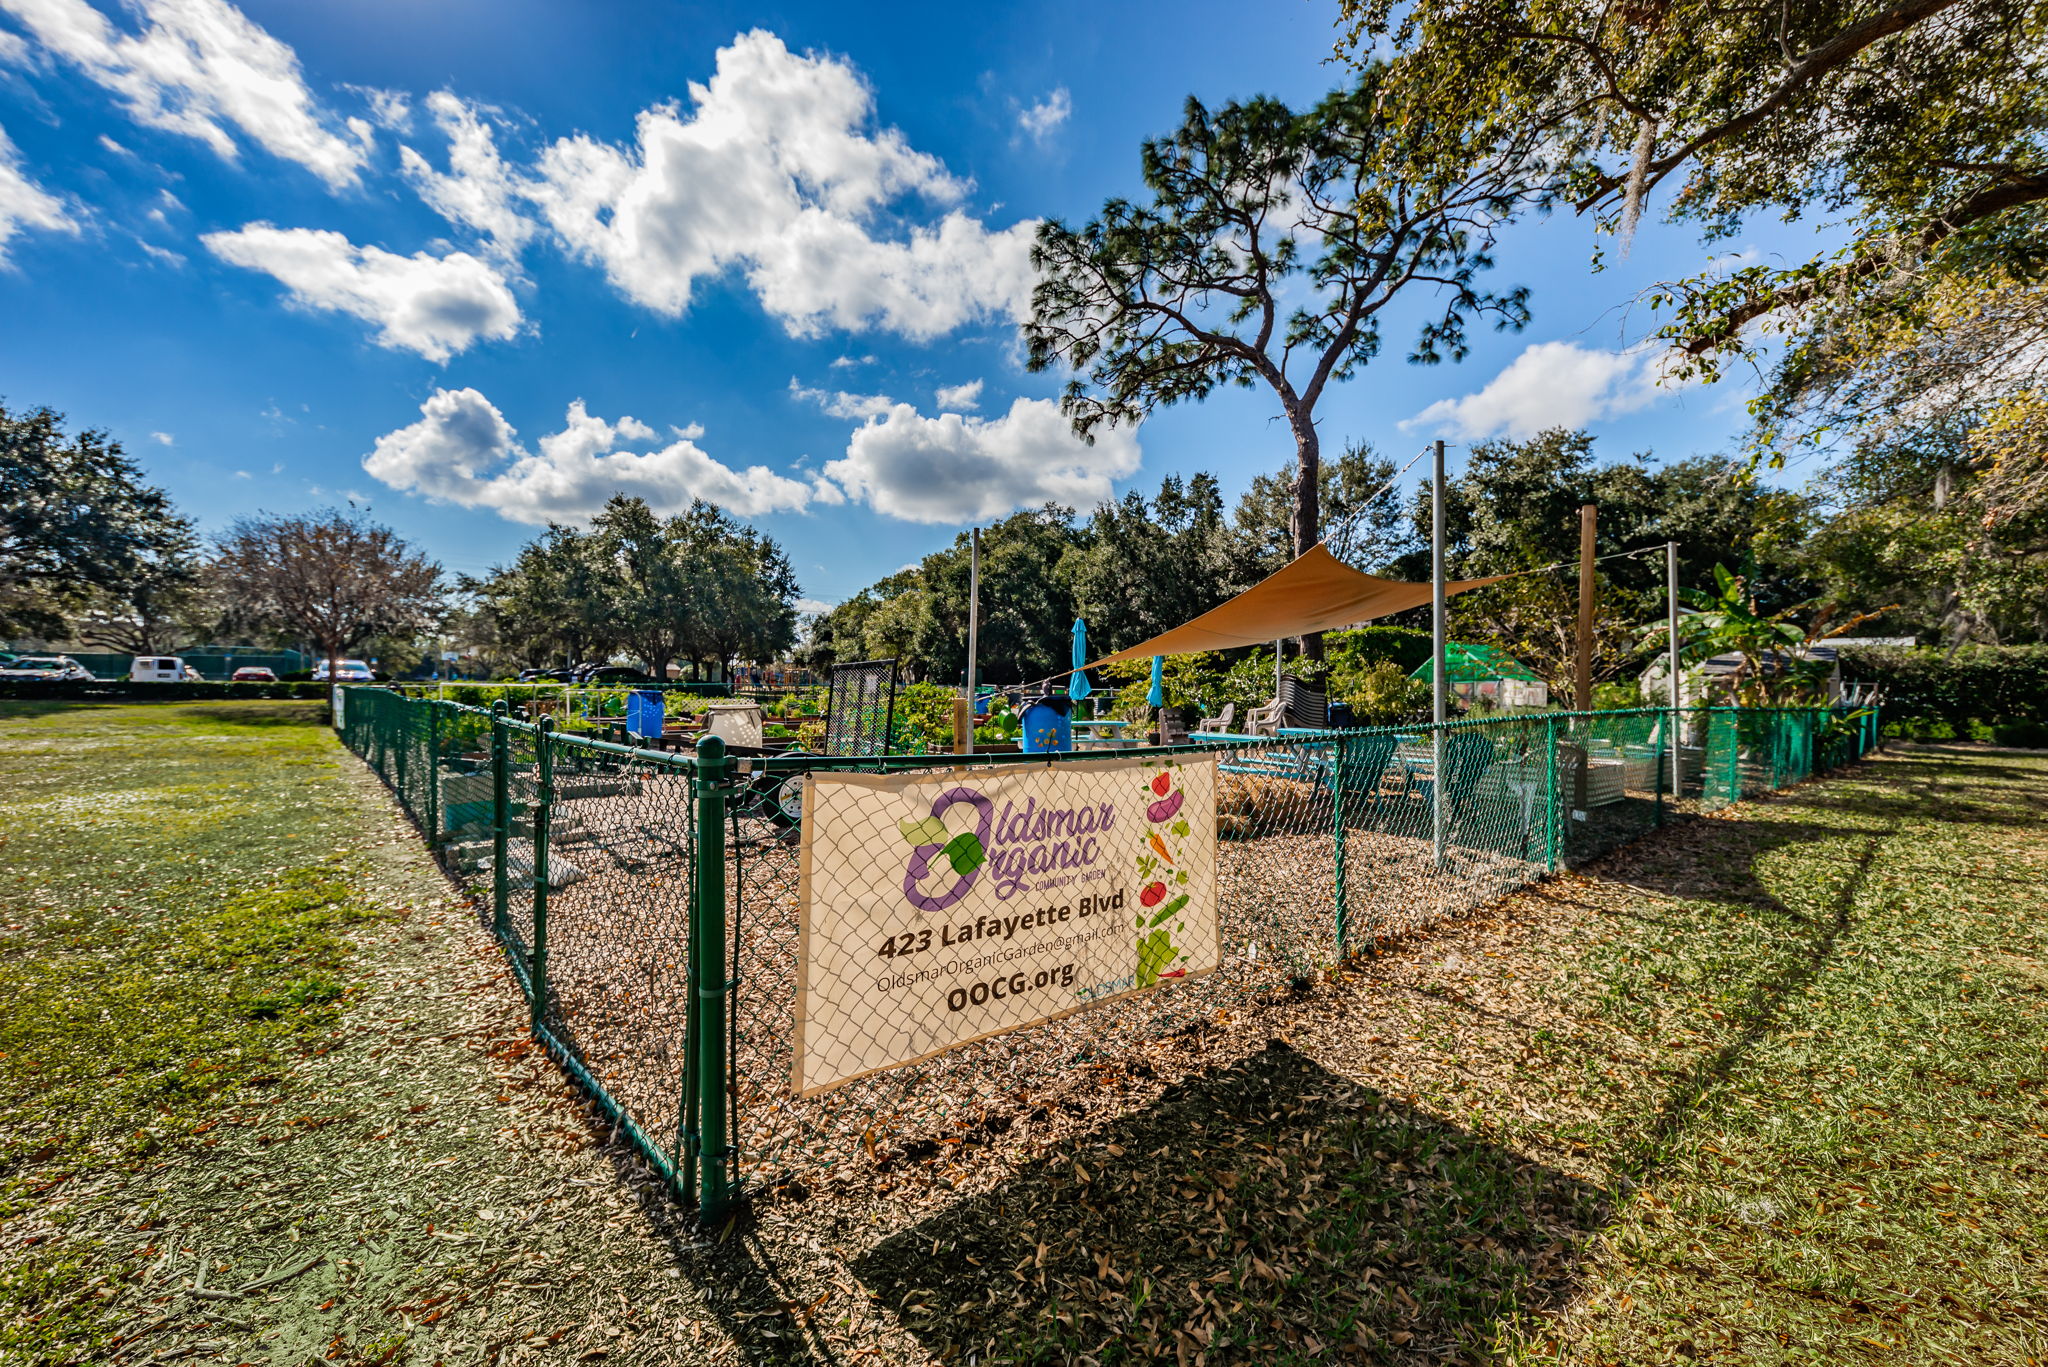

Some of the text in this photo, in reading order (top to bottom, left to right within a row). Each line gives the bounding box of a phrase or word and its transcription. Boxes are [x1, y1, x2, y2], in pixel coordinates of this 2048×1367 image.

[1035, 869, 1106, 892] COMMUNITY GARDEN
[877, 888, 1124, 959] 423 Lafayette Blvd
[877, 922, 1125, 993] OldsmarOrganicGarden@gmail.com
[946, 963, 1075, 1013] OOCG.org
[1080, 975, 1136, 1001] OLDSMAR
